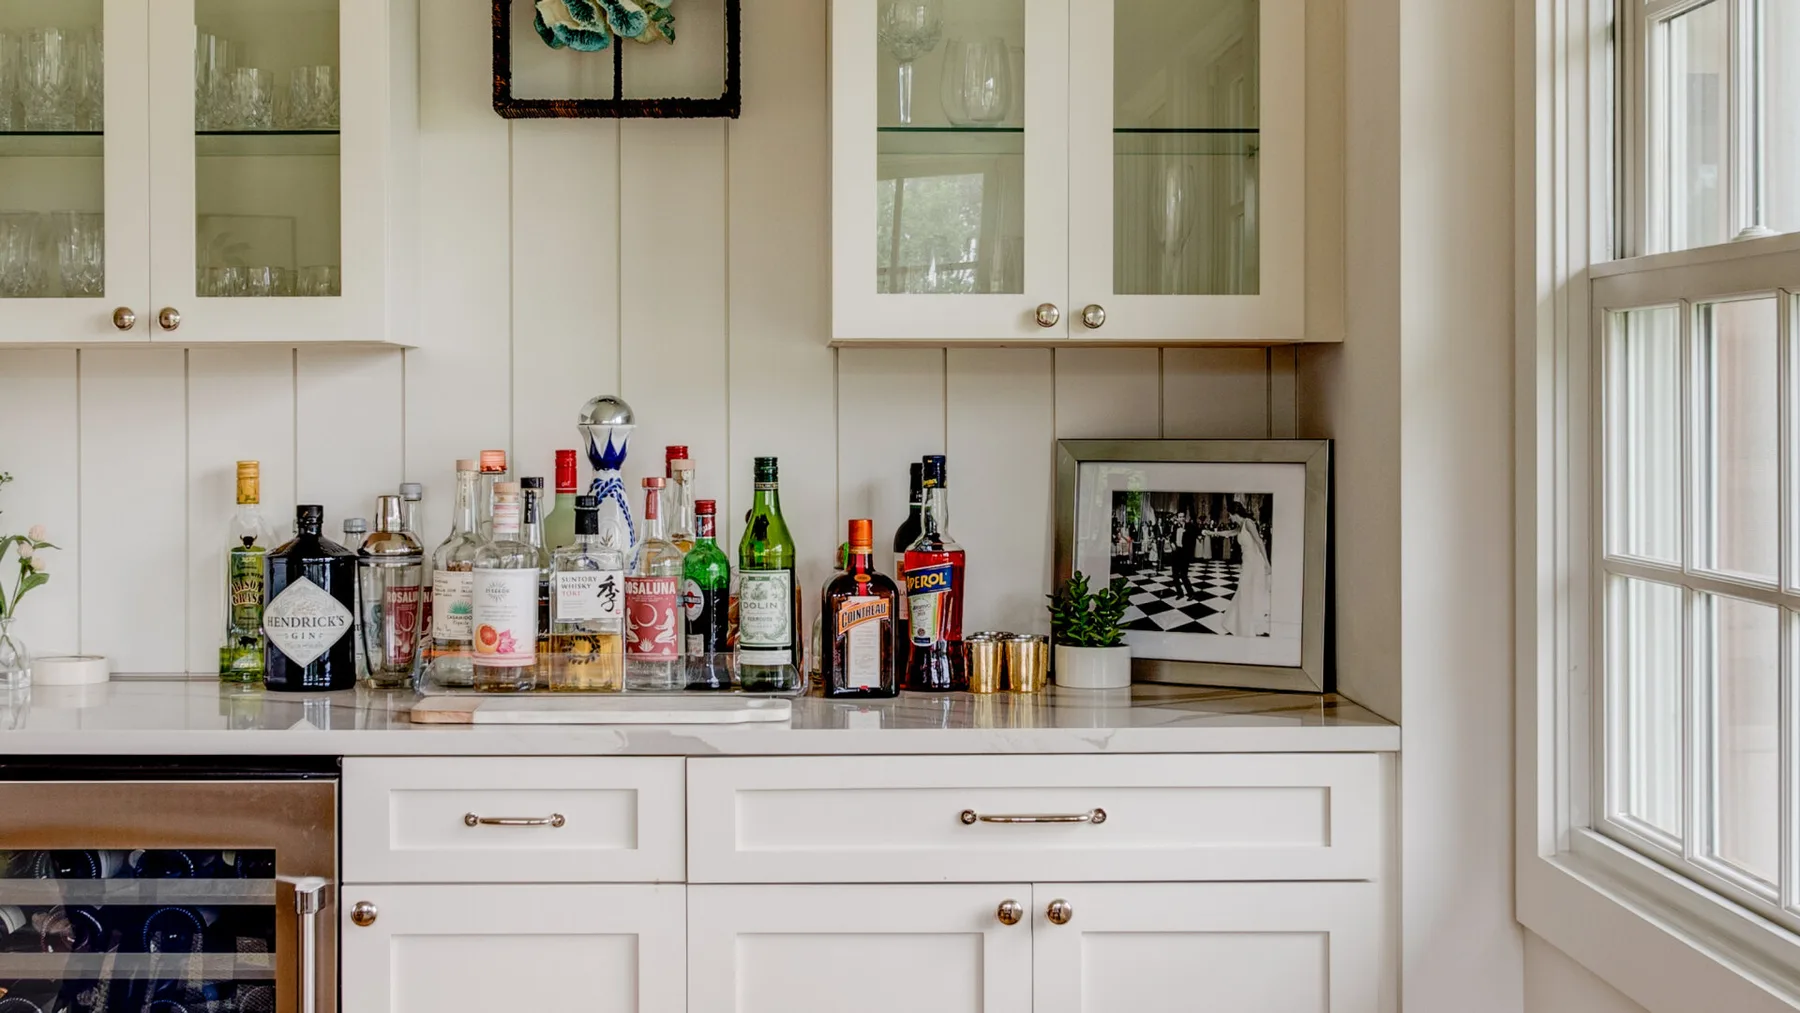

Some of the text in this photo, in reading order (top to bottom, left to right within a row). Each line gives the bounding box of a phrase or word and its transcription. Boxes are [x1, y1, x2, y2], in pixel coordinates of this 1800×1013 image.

[597, 575, 620, 612] 季
[267, 615, 345, 628] HENDRICK'S
[842, 603, 886, 628] COINTREAU
[291, 632, 316, 640] GIN
